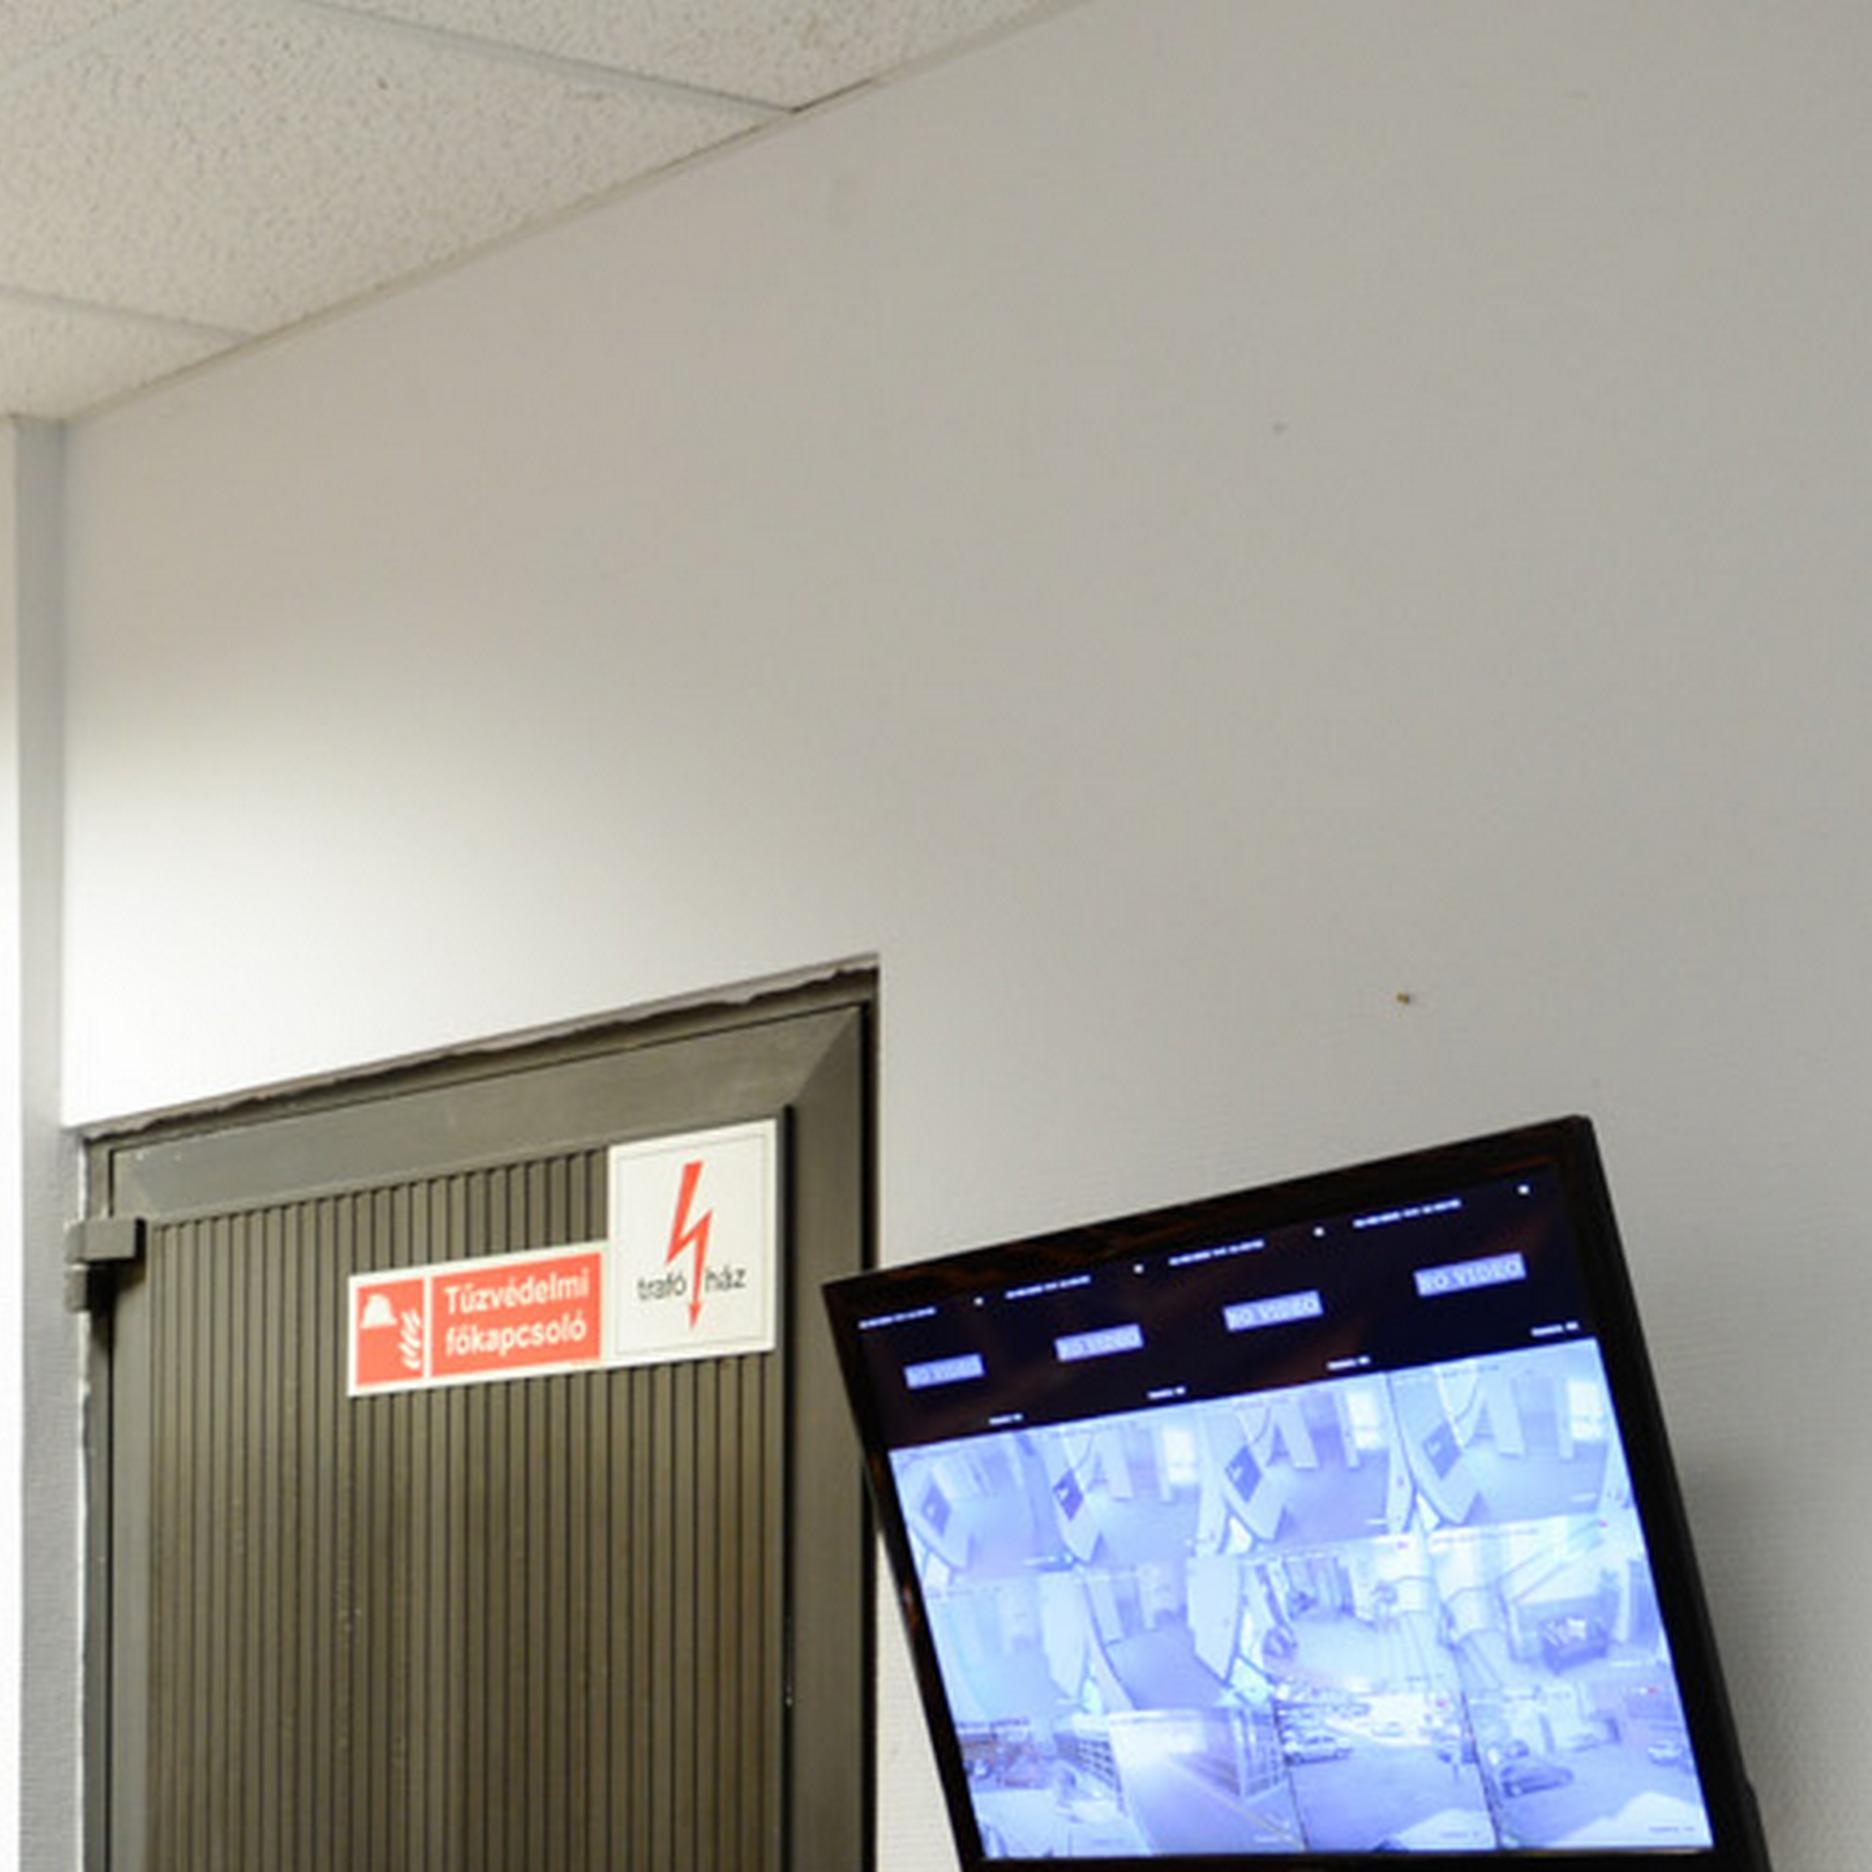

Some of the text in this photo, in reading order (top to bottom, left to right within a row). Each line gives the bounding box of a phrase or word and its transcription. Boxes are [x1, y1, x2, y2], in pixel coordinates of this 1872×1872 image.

[443, 1266, 591, 1316] Tűzvédelmi
[636, 1264, 747, 1301] trafó ház
[1453, 1255, 1526, 1288] VIDEO
[444, 1308, 589, 1358] főkapcsoló
